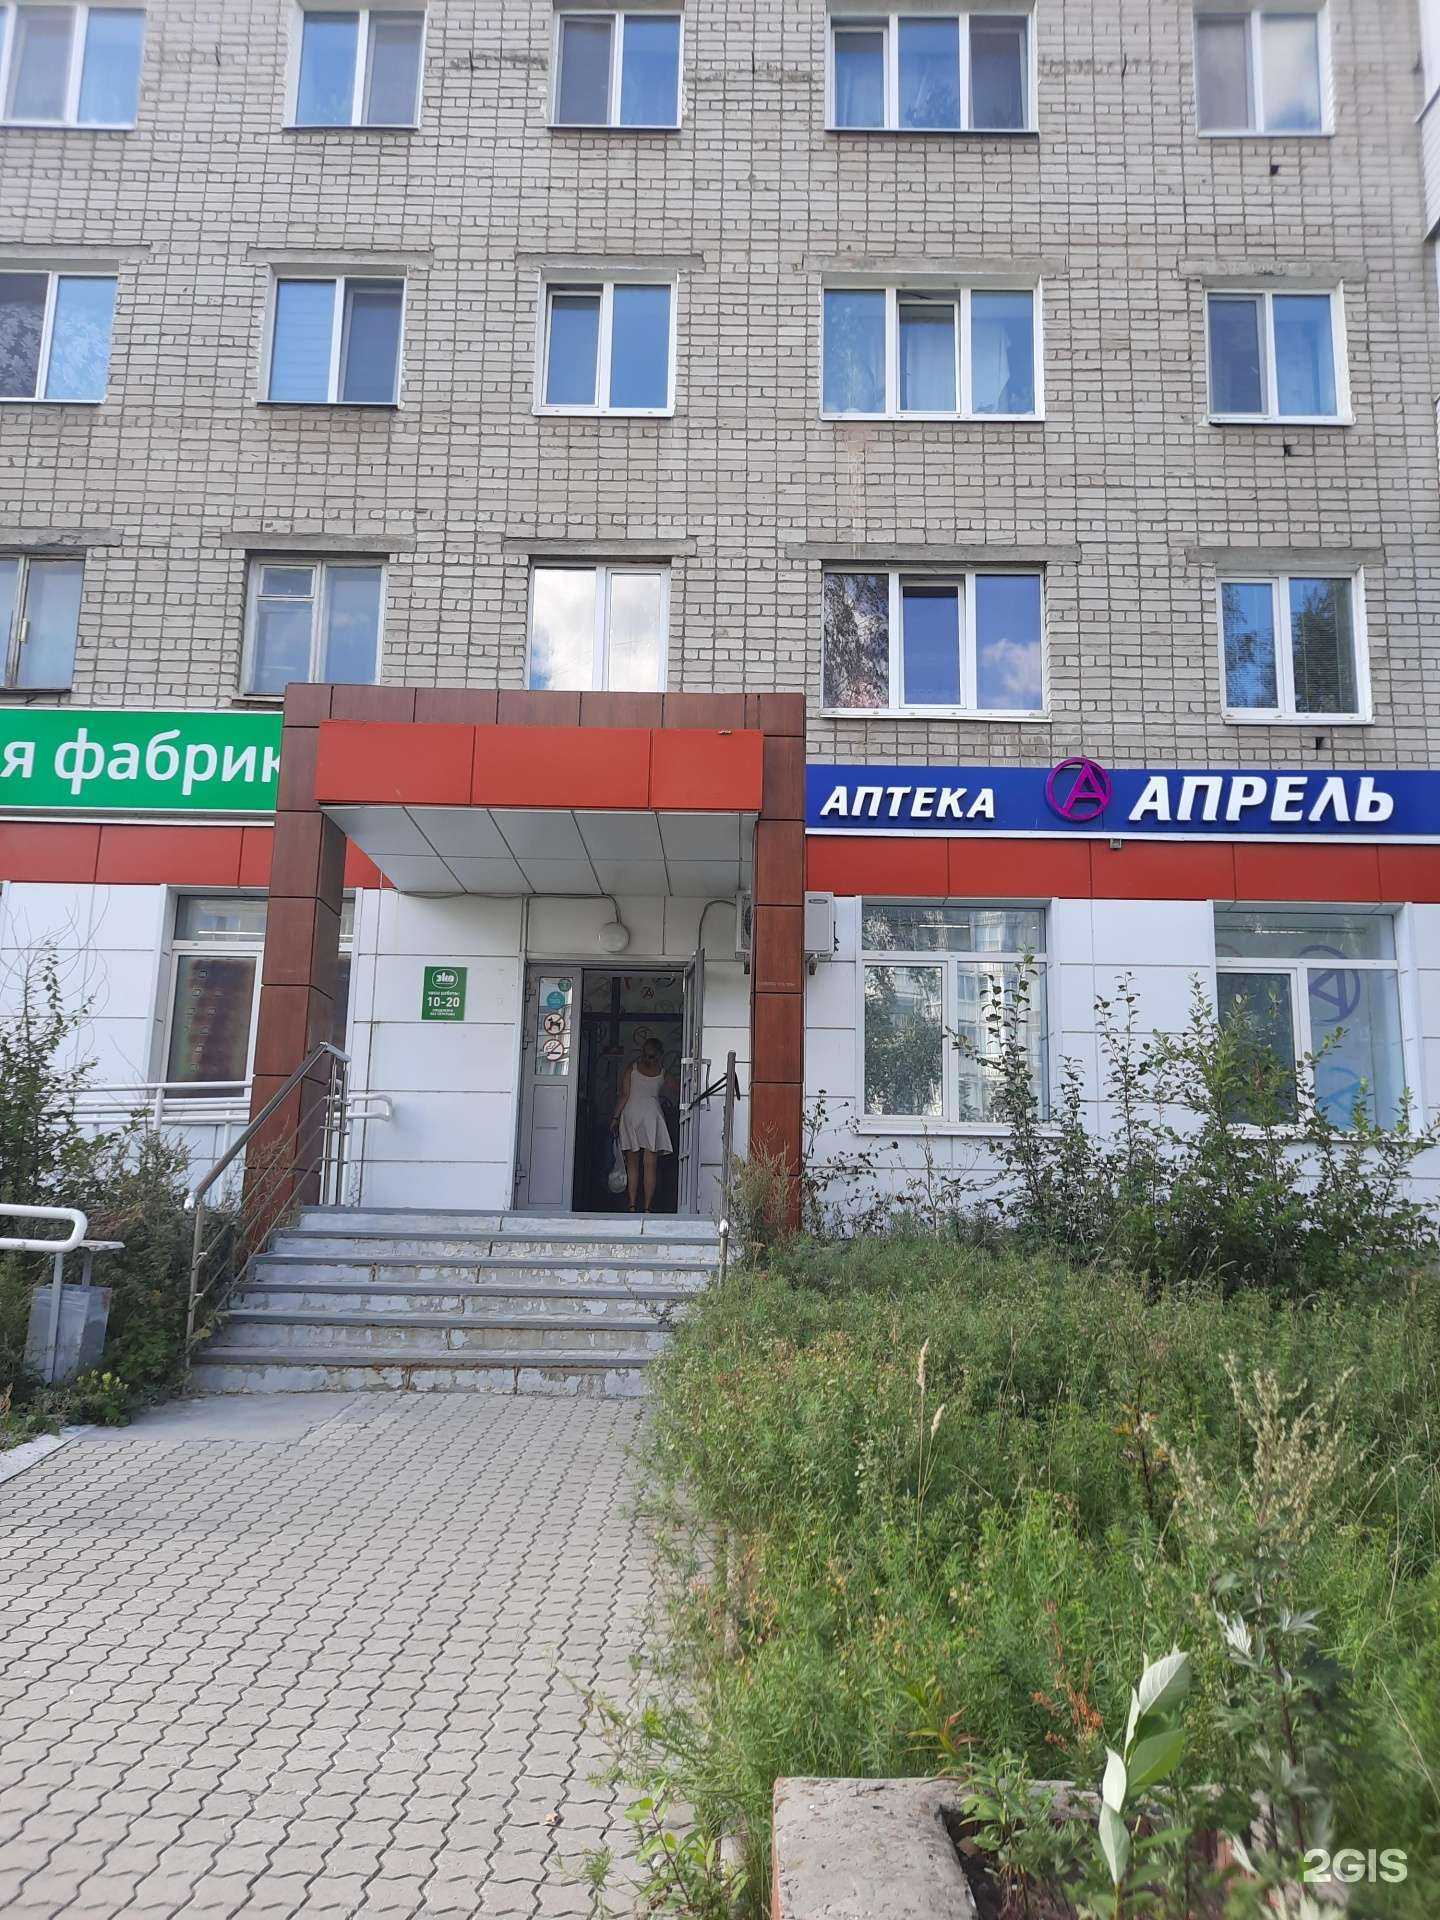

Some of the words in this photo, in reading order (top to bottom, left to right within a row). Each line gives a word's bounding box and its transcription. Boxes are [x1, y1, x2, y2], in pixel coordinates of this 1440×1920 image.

[820, 786, 995, 818] АПТЕКА
[1128, 775, 1395, 823] АПРЕЛЬ
[427, 996, 460, 1008] 10-20
